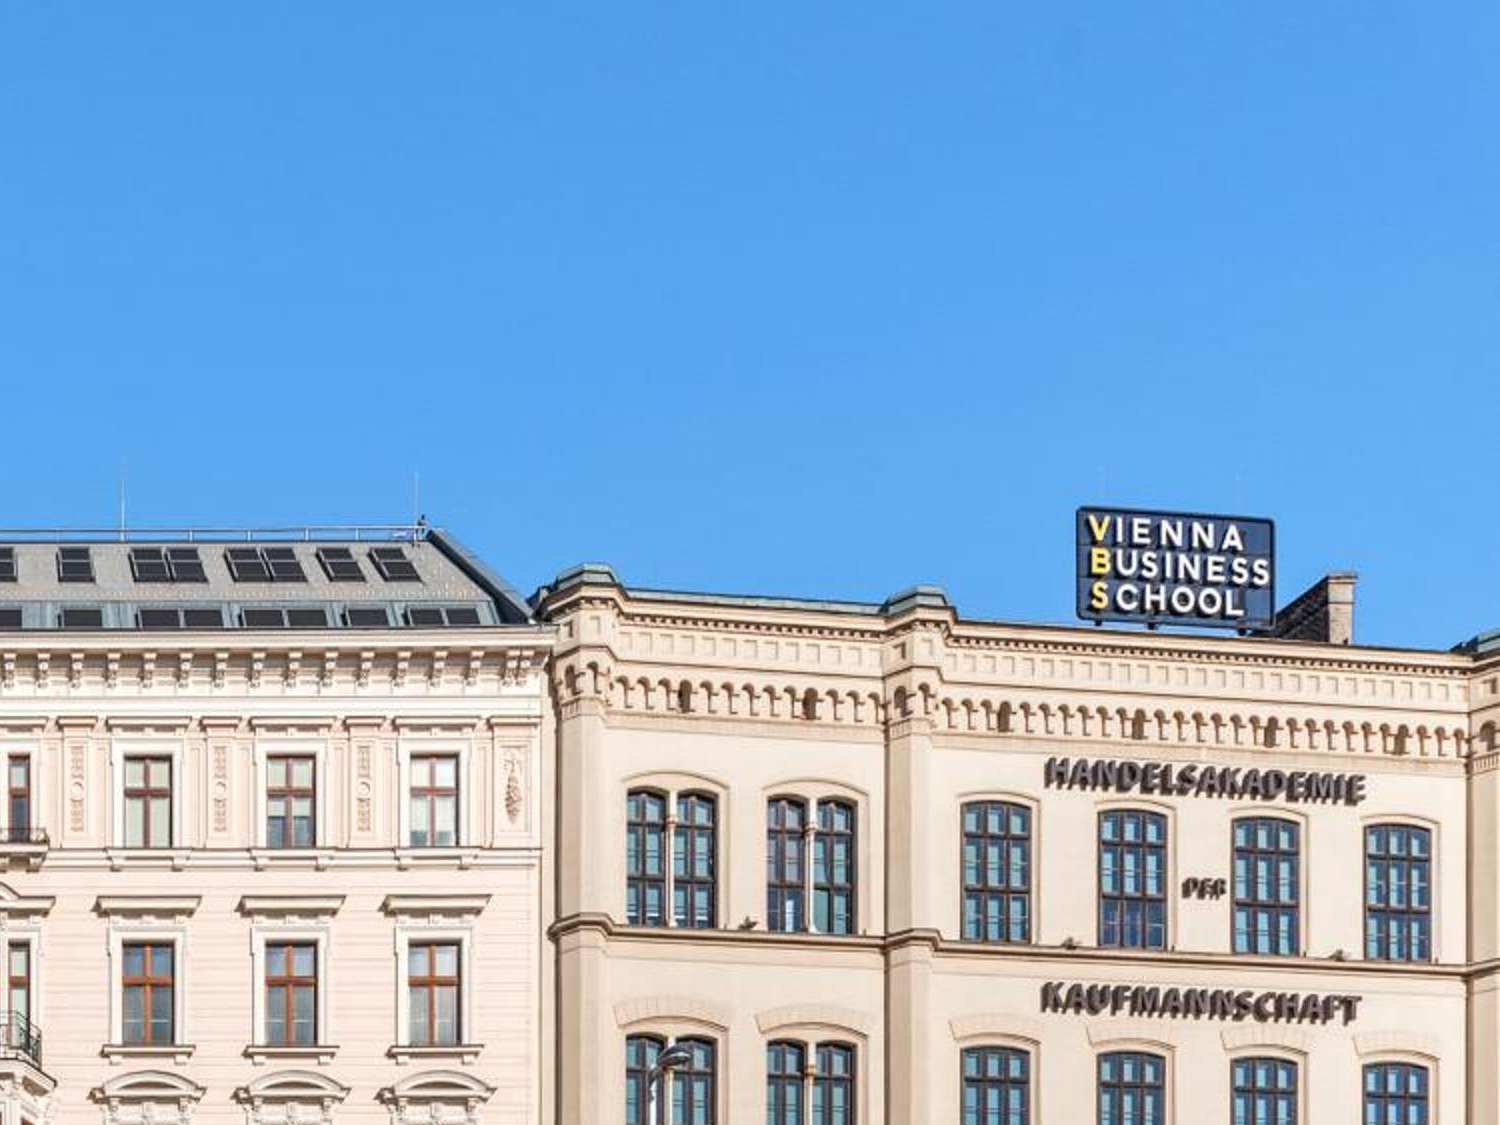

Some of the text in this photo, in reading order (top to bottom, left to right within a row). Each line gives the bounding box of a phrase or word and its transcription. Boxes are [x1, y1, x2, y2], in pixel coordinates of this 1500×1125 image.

[1088, 513, 1244, 551] VIENNA
[1090, 546, 1270, 586] BUSINESS
[1090, 580, 1245, 616] SCHOOL
[1044, 757, 1367, 806] HANDELSAKADEMIE
[1040, 981, 1363, 1026] KAUFMANNSCHAFT
